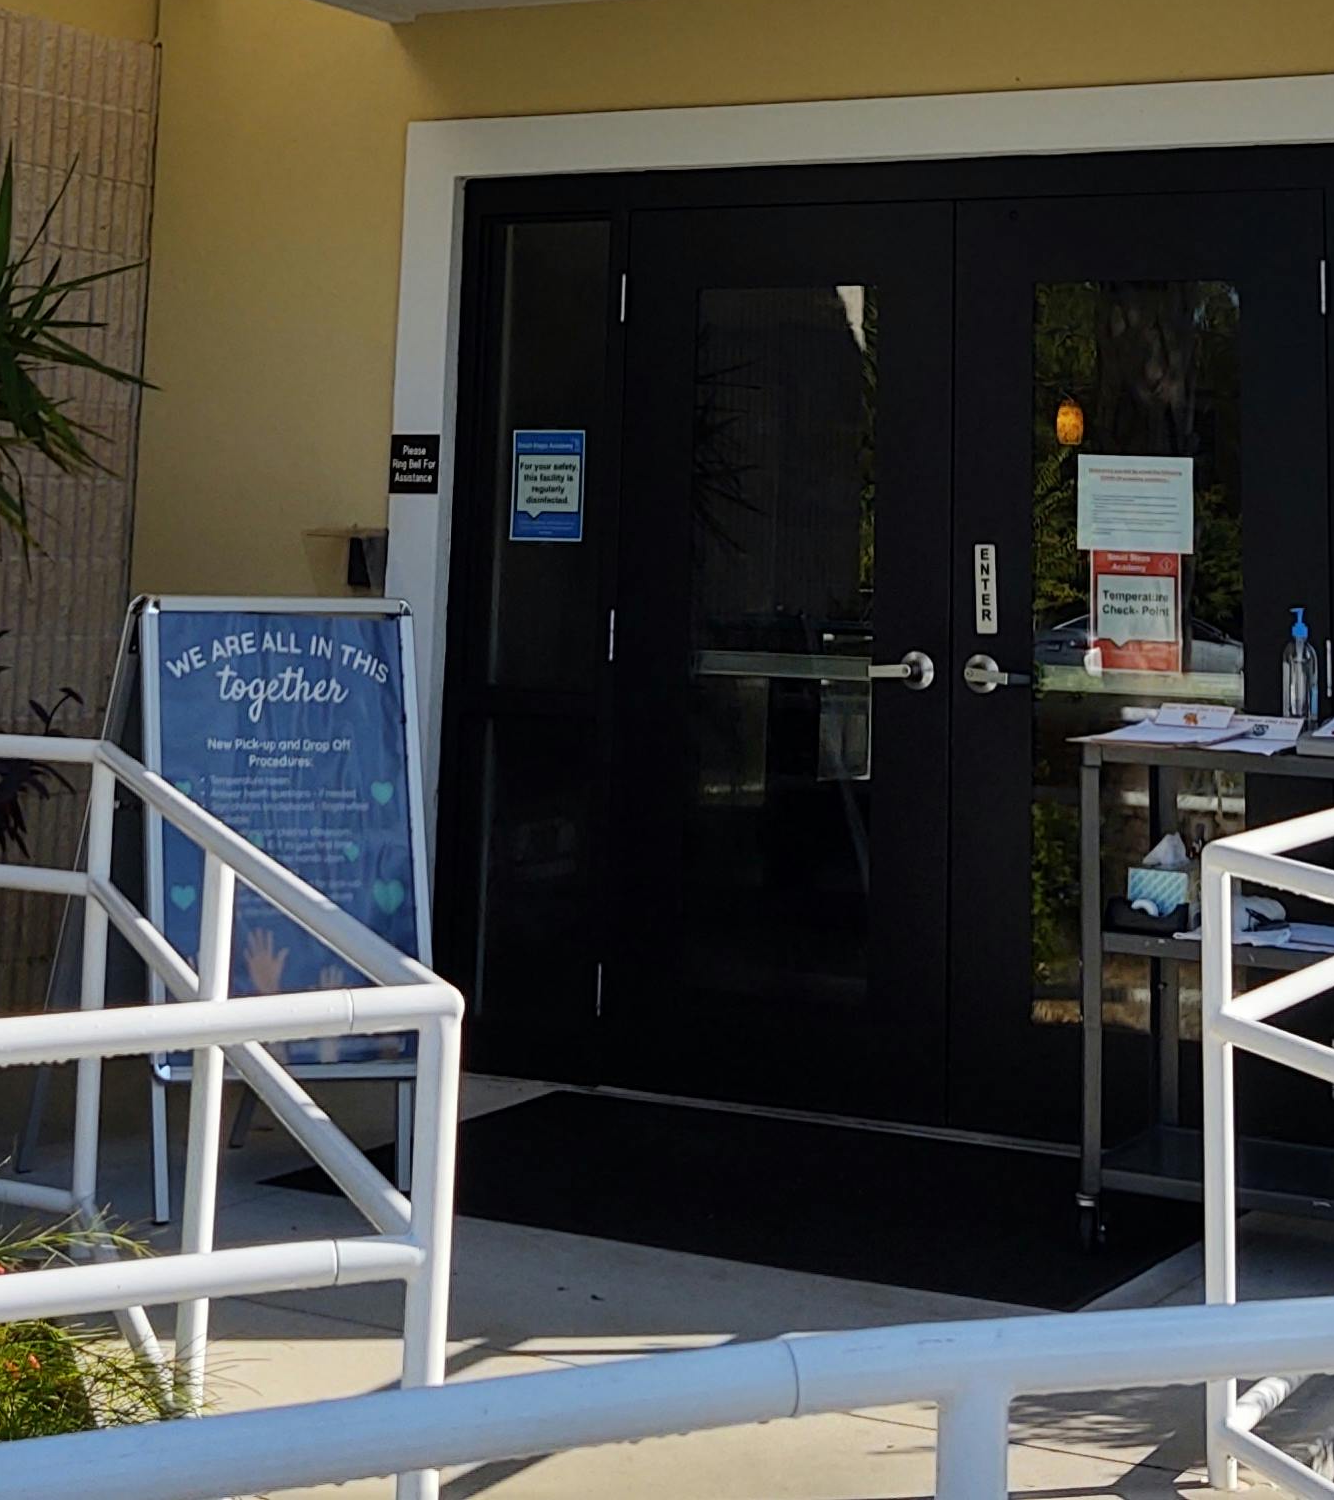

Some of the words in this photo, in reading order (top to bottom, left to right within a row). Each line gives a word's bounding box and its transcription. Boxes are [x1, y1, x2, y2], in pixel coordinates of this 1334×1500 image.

[402, 444, 427, 456] Please
[392, 458, 407, 471] Ring
[408, 458, 421, 469] Bell
[423, 458, 436, 469] For
[520, 462, 533, 470] For
[534, 463, 552, 472] your
[394, 471, 433, 483] Assistance
[524, 473, 538, 482] this
[539, 473, 565, 483] facility
[566, 473, 574, 482] is
[531, 485, 565, 495] regularly
[979, 548, 992, 622] ENTER
[1141, 605, 1169, 617] Point
[166, 646, 207, 679] WE
[211, 632, 257, 663] ARE
[261, 632, 303, 654] ALL
[309, 635, 333, 660] IN
[340, 644, 390, 684] THIS
[216, 664, 349, 723] together
[207, 738, 233, 750] New
[234, 737, 276, 753] Pick-up
[278, 738, 301, 750] and
[302, 739, 330, 753] Drop
[332, 739, 351, 750] Off
[248, 754, 314, 768] Procedures:
